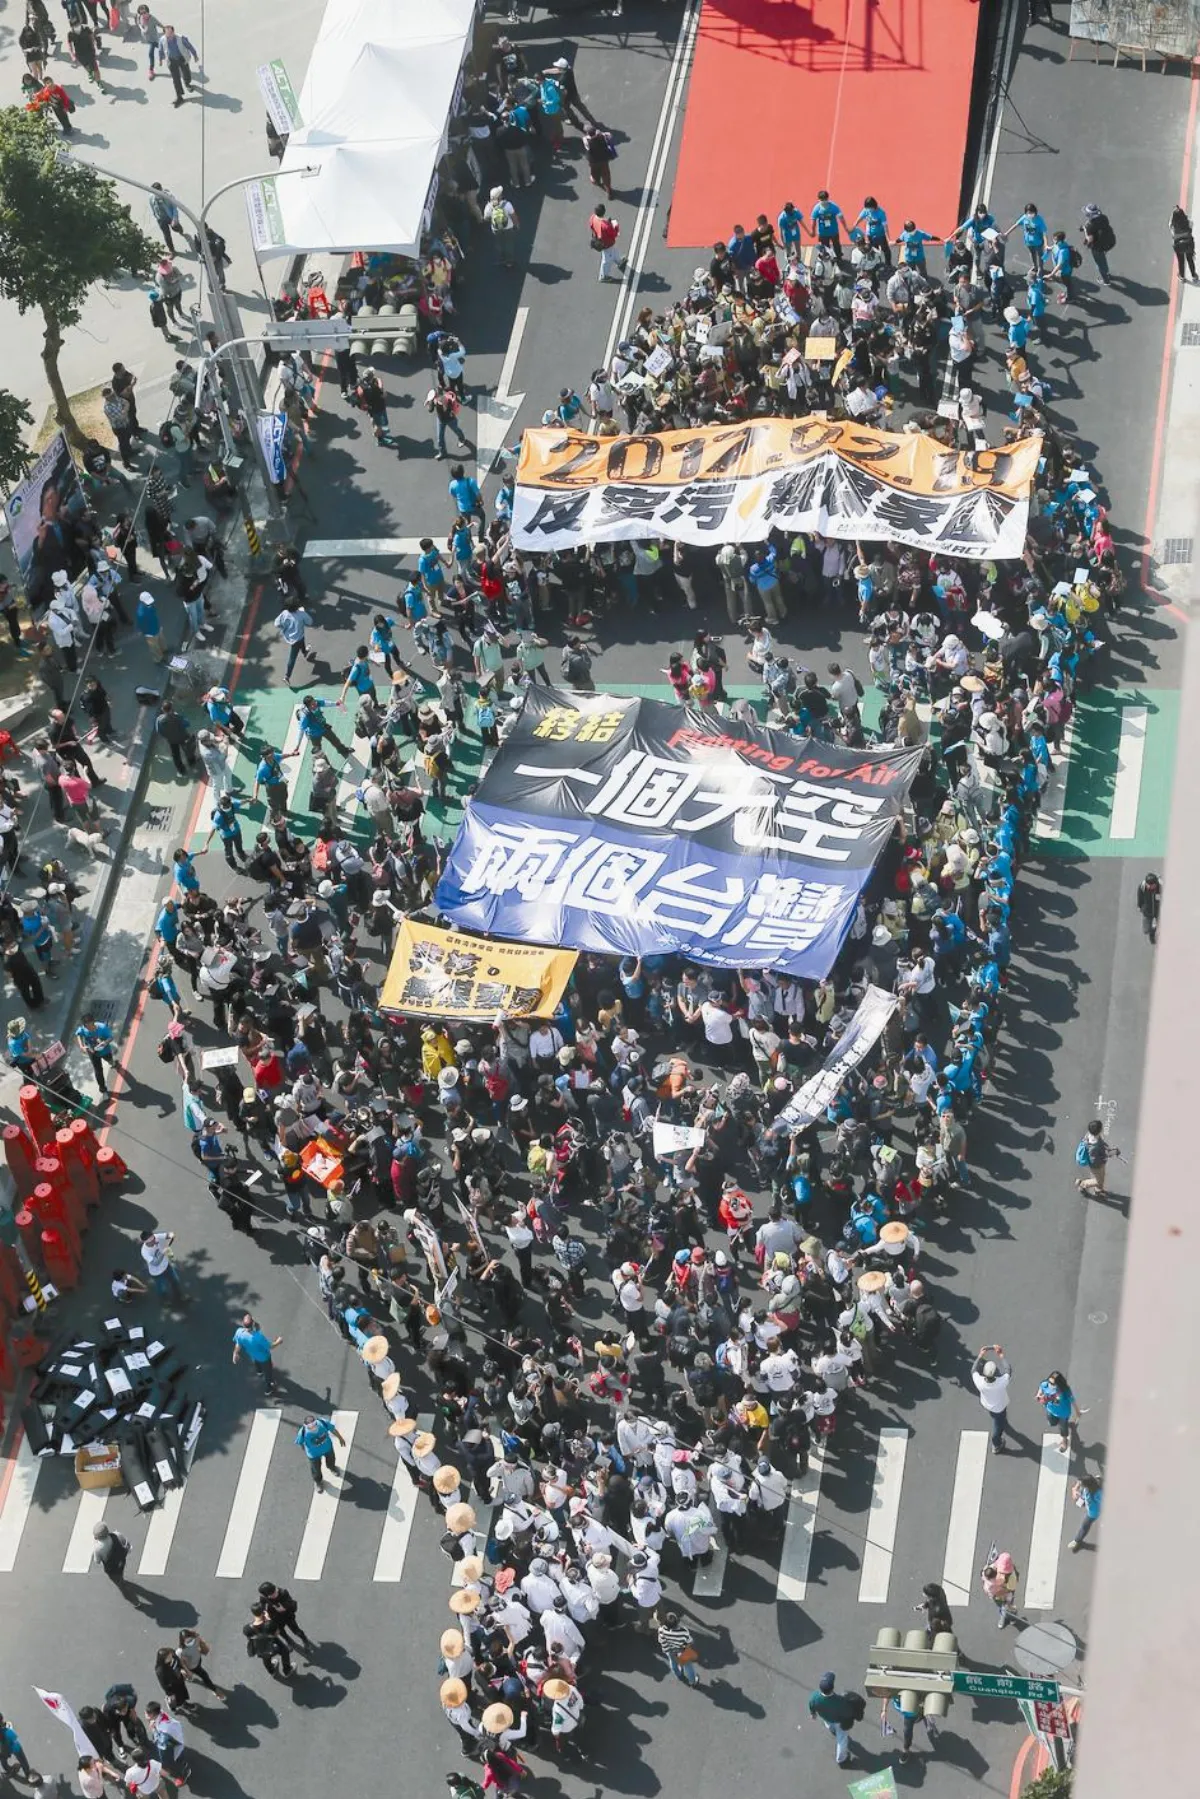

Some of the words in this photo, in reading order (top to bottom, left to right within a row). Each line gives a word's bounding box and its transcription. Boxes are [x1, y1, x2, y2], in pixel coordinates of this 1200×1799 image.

[525, 483, 738, 534] 反空污
[952, 545, 991, 556] ACT
[532, 706, 625, 742] 終結
[667, 728, 795, 771] Fighting
[797, 759, 847, 777] for
[844, 763, 900, 786] Air
[513, 748, 885, 862] 一個天空
[460, 822, 845, 952] 兩個台灣
[1028, 1689, 1044, 1698] Rd
